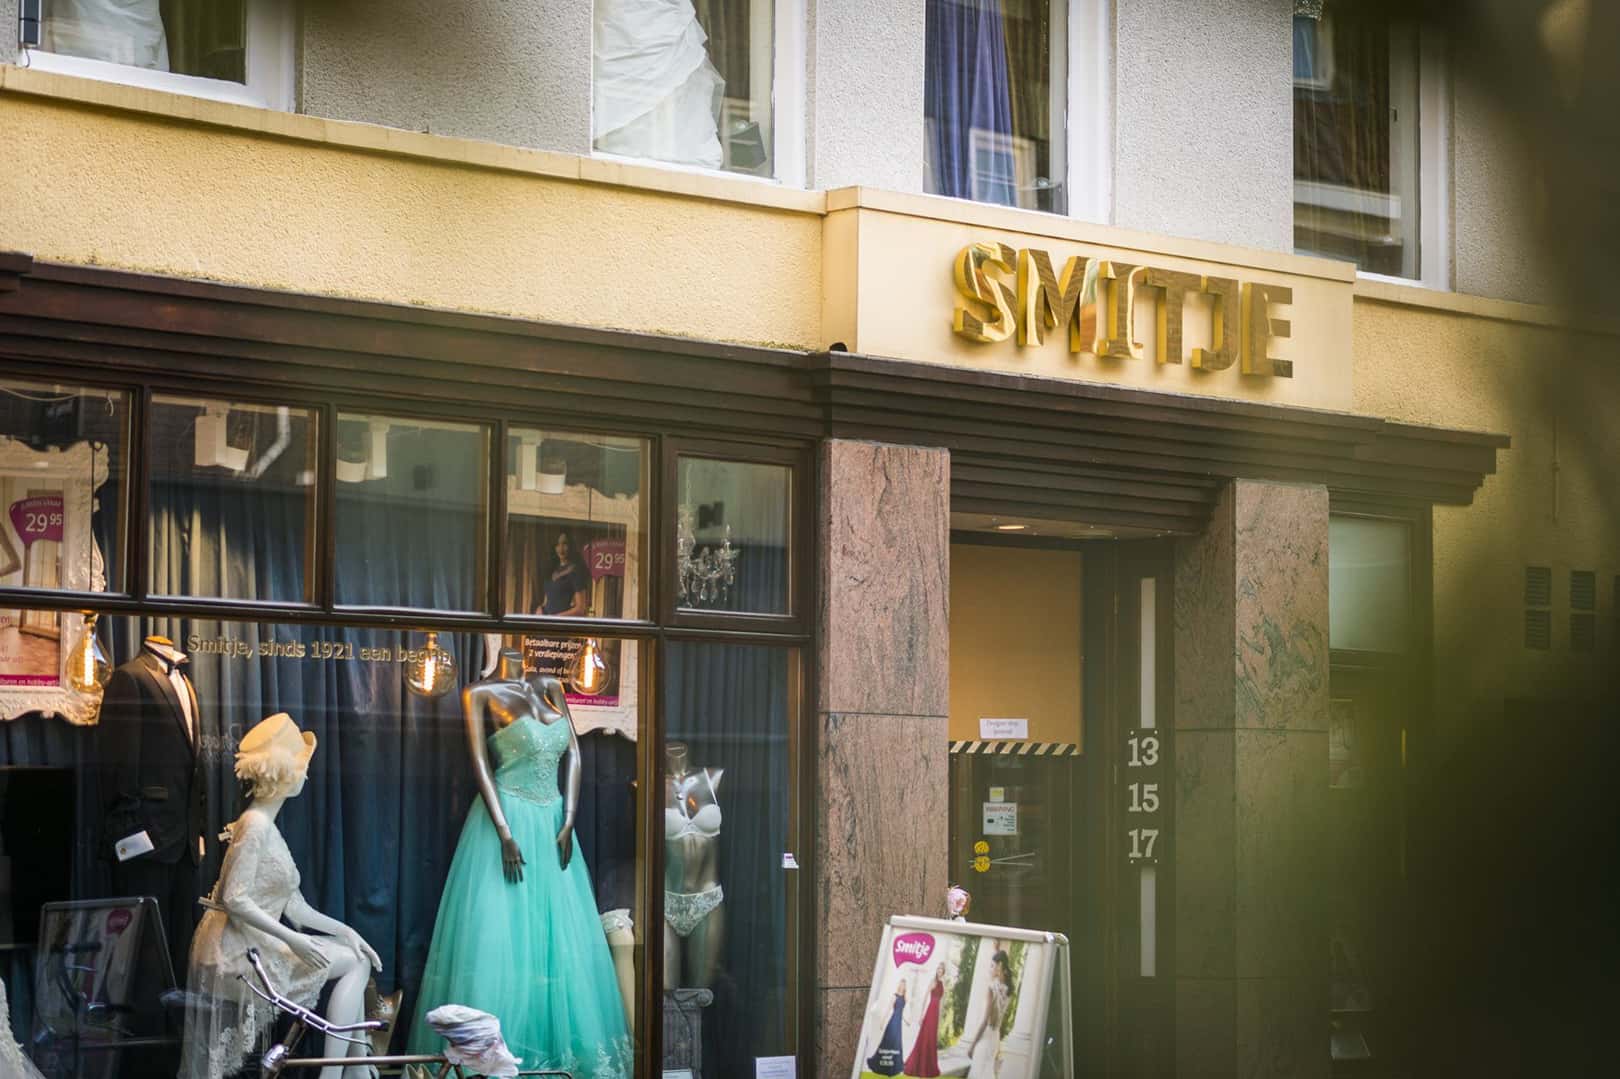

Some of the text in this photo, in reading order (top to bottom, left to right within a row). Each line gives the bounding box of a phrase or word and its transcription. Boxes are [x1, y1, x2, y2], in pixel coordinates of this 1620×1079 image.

[953, 241, 1294, 380] SMITJE
[187, 633, 253, 659] Smitje,
[258, 638, 306, 659] sinds
[311, 641, 354, 661] 1921
[359, 647, 391, 662] een
[1128, 736, 1159, 766] 13
[1128, 782, 1159, 812] 15
[1128, 828, 1159, 858] 17
[895, 940, 930, 958] Smitje
